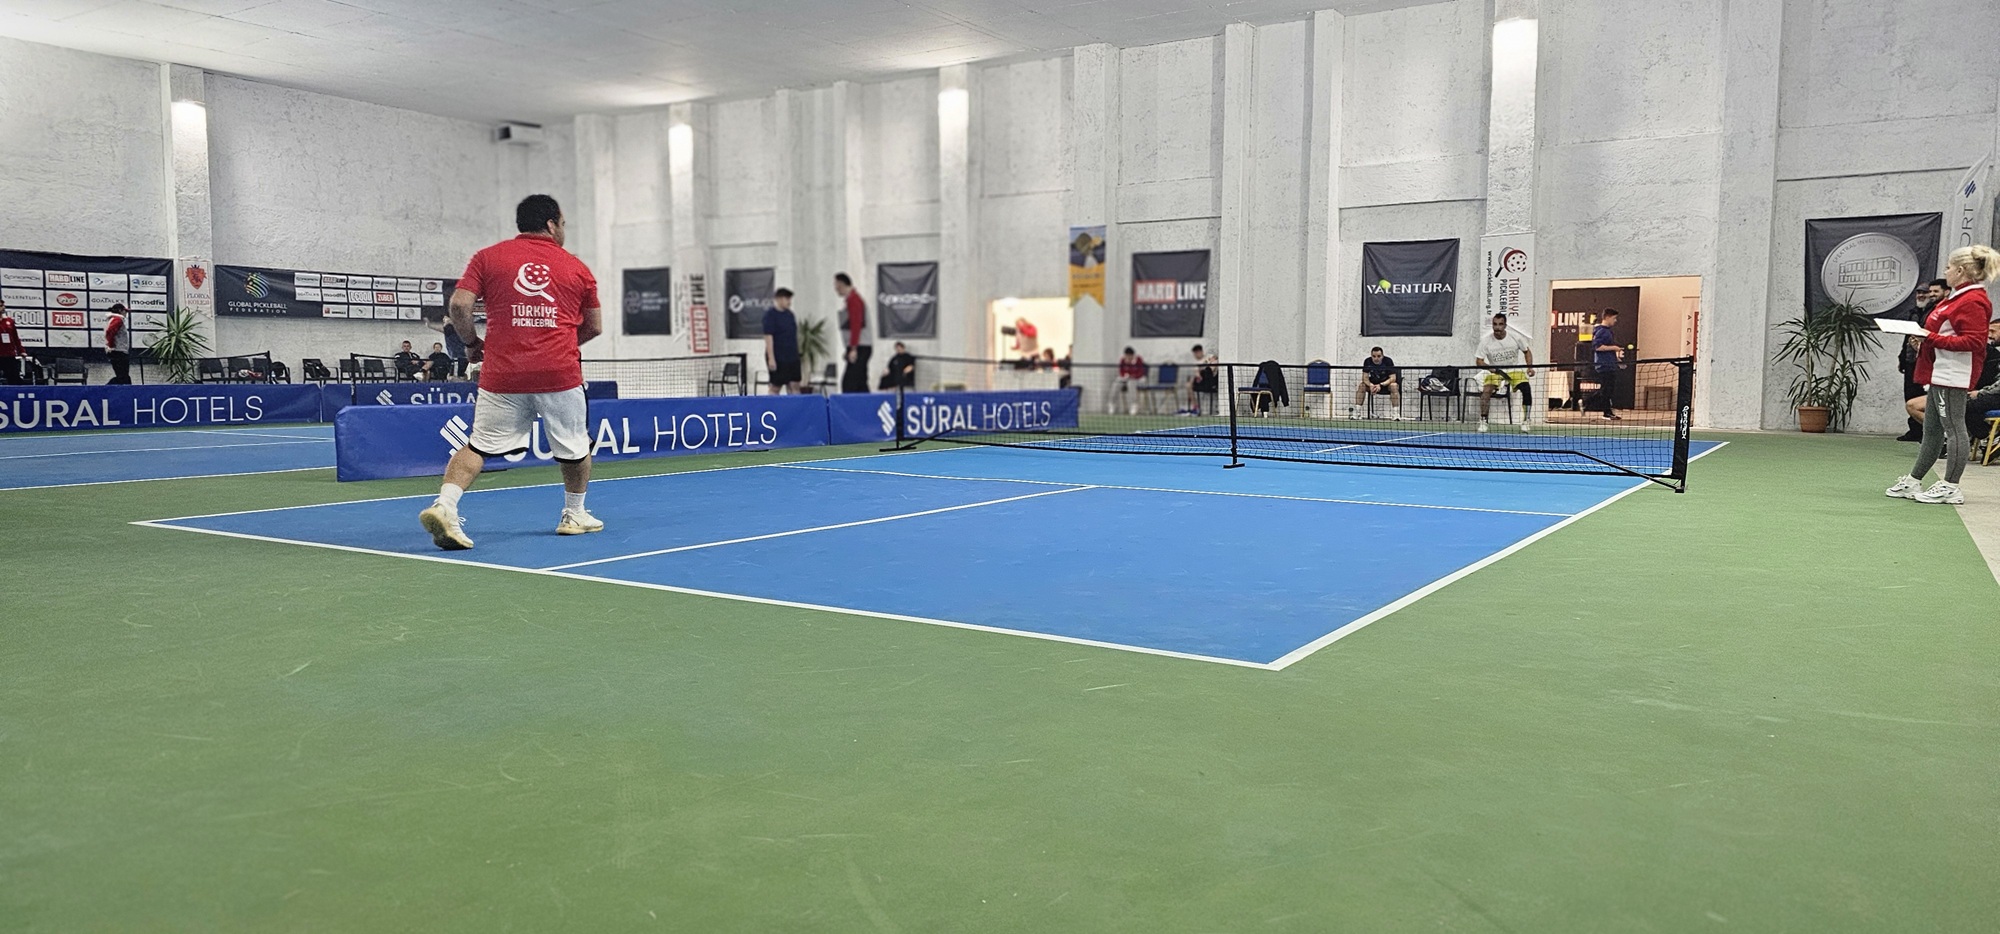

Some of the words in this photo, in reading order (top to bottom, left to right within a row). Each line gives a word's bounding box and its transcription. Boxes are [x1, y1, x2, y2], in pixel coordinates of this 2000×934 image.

[1136, 281, 1174, 301] HARD
[1176, 281, 1207, 300] LINE
[1366, 283, 1453, 295] VALENTURA
[1485, 250, 1493, 316] www.pickleball.org.tr
[253, 302, 288, 310] PICKLEBALL
[1508, 277, 1522, 317] TÜRKİYE
[511, 302, 558, 319] TÜRKİYE
[1557, 312, 1586, 326] LINE
[512, 317, 558, 328] PICKLEBALL
[134, 395, 264, 424] HOTELS
[907, 397, 978, 434] SÜRAL
[982, 401, 1051, 430] HOTELS
[504, 411, 640, 462] ÜAL
[654, 411, 778, 452] HOTELS
